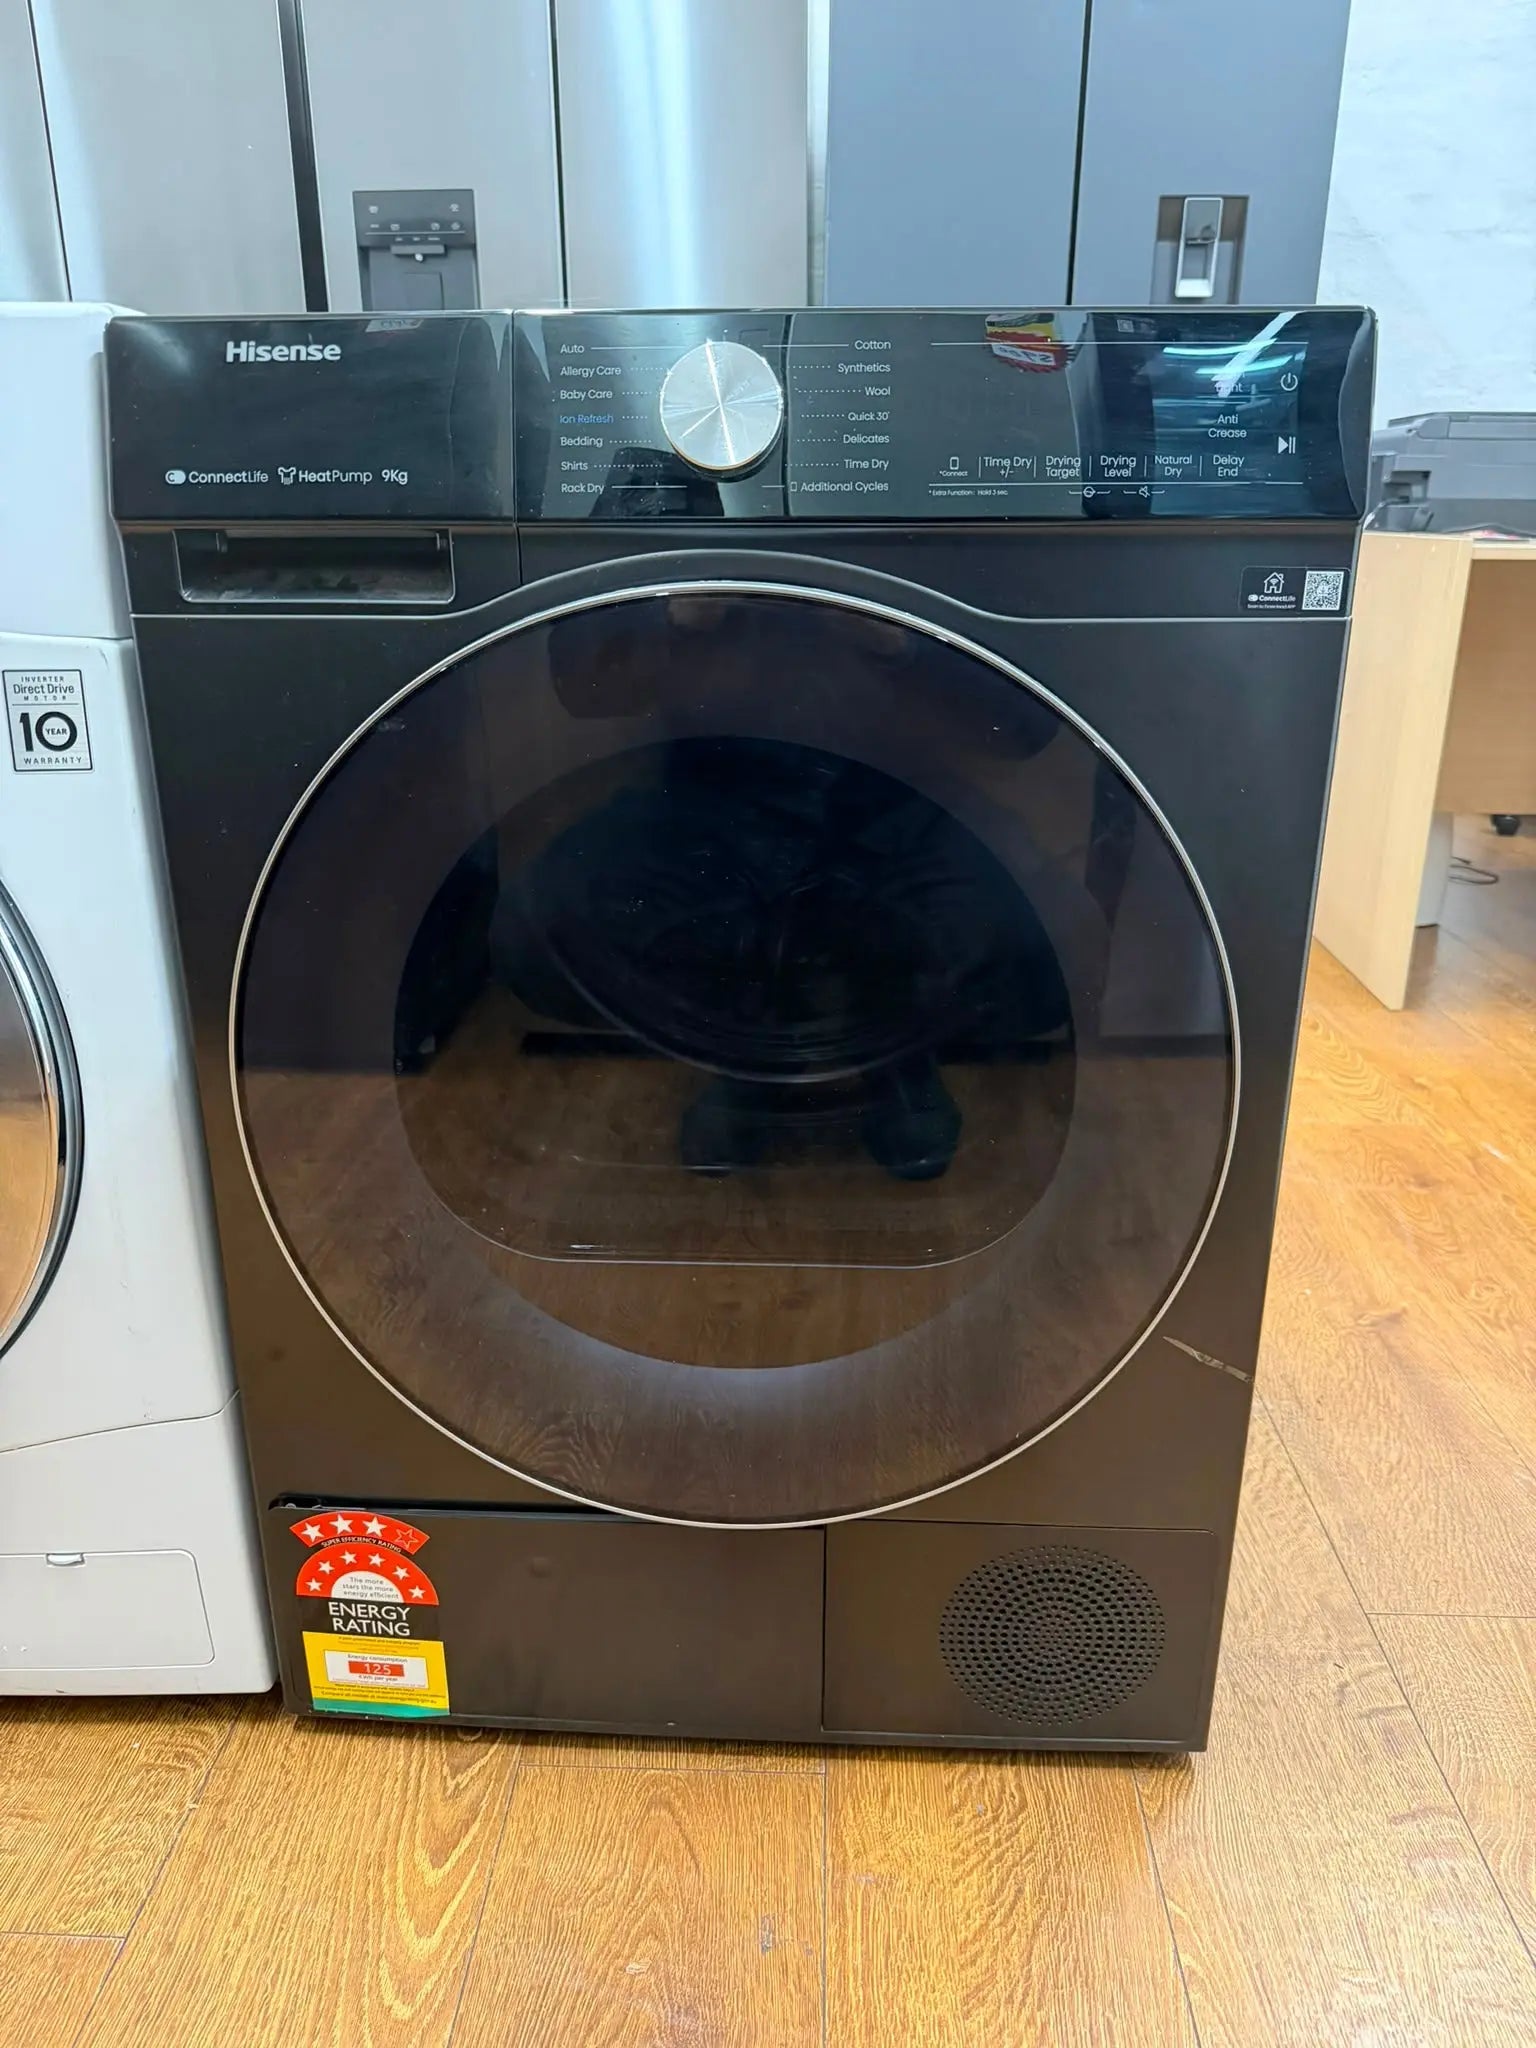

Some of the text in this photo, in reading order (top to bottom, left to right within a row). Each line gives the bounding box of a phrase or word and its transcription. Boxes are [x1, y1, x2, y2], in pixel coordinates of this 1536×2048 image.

[560, 344, 585, 353] Auto
[854, 340, 891, 350] Cotton
[226, 341, 341, 362] Hisense
[560, 365, 621, 377] Allergy Care
[837, 363, 891, 374] Synthetics
[560, 389, 613, 401] Baby Care
[864, 386, 891, 396] Wool
[560, 414, 614, 424] Ion Refresh
[848, 411, 875, 422] Quick
[1217, 414, 1239, 424] Anti
[843, 433, 890, 444] Delicates
[1208, 428, 1247, 438] Crease
[560, 437, 603, 449] Bedding
[561, 460, 588, 471] Shirts
[844, 459, 890, 472] Time Dry
[984, 456, 1033, 469] Time Dry
[1045, 455, 1081, 468] Drying
[1100, 455, 1137, 468] Drying
[1154, 455, 1193, 465] Natural
[1212, 454, 1245, 467] Delay
[189, 470, 269, 484] ConnectLife
[299, 469, 408, 485] HeatPump 9Kg
[1045, 467, 1080, 479] Target
[1104, 467, 1132, 477] Level
[1164, 466, 1182, 477] Dry
[1218, 466, 1239, 477] End
[561, 483, 605, 495] Rack Dry
[801, 481, 889, 494] Additional Cycles
[1259, 594, 1296, 602] ConnectLife
[13, 683, 75, 694] Direct Drive
[19, 711, 78, 752] 10
[45, 727, 68, 736] YEAR
[24, 757, 82, 765] WARRANTY
[320, 1536, 402, 1553] SUPER EFFICIENCY RATING
[343, 1590, 399, 1599] energy efficient
[328, 1601, 411, 1621] ENERGY
[332, 1617, 411, 1636] RATING
[348, 1653, 408, 1663] Energy consumption
[364, 1663, 392, 1675] 125
